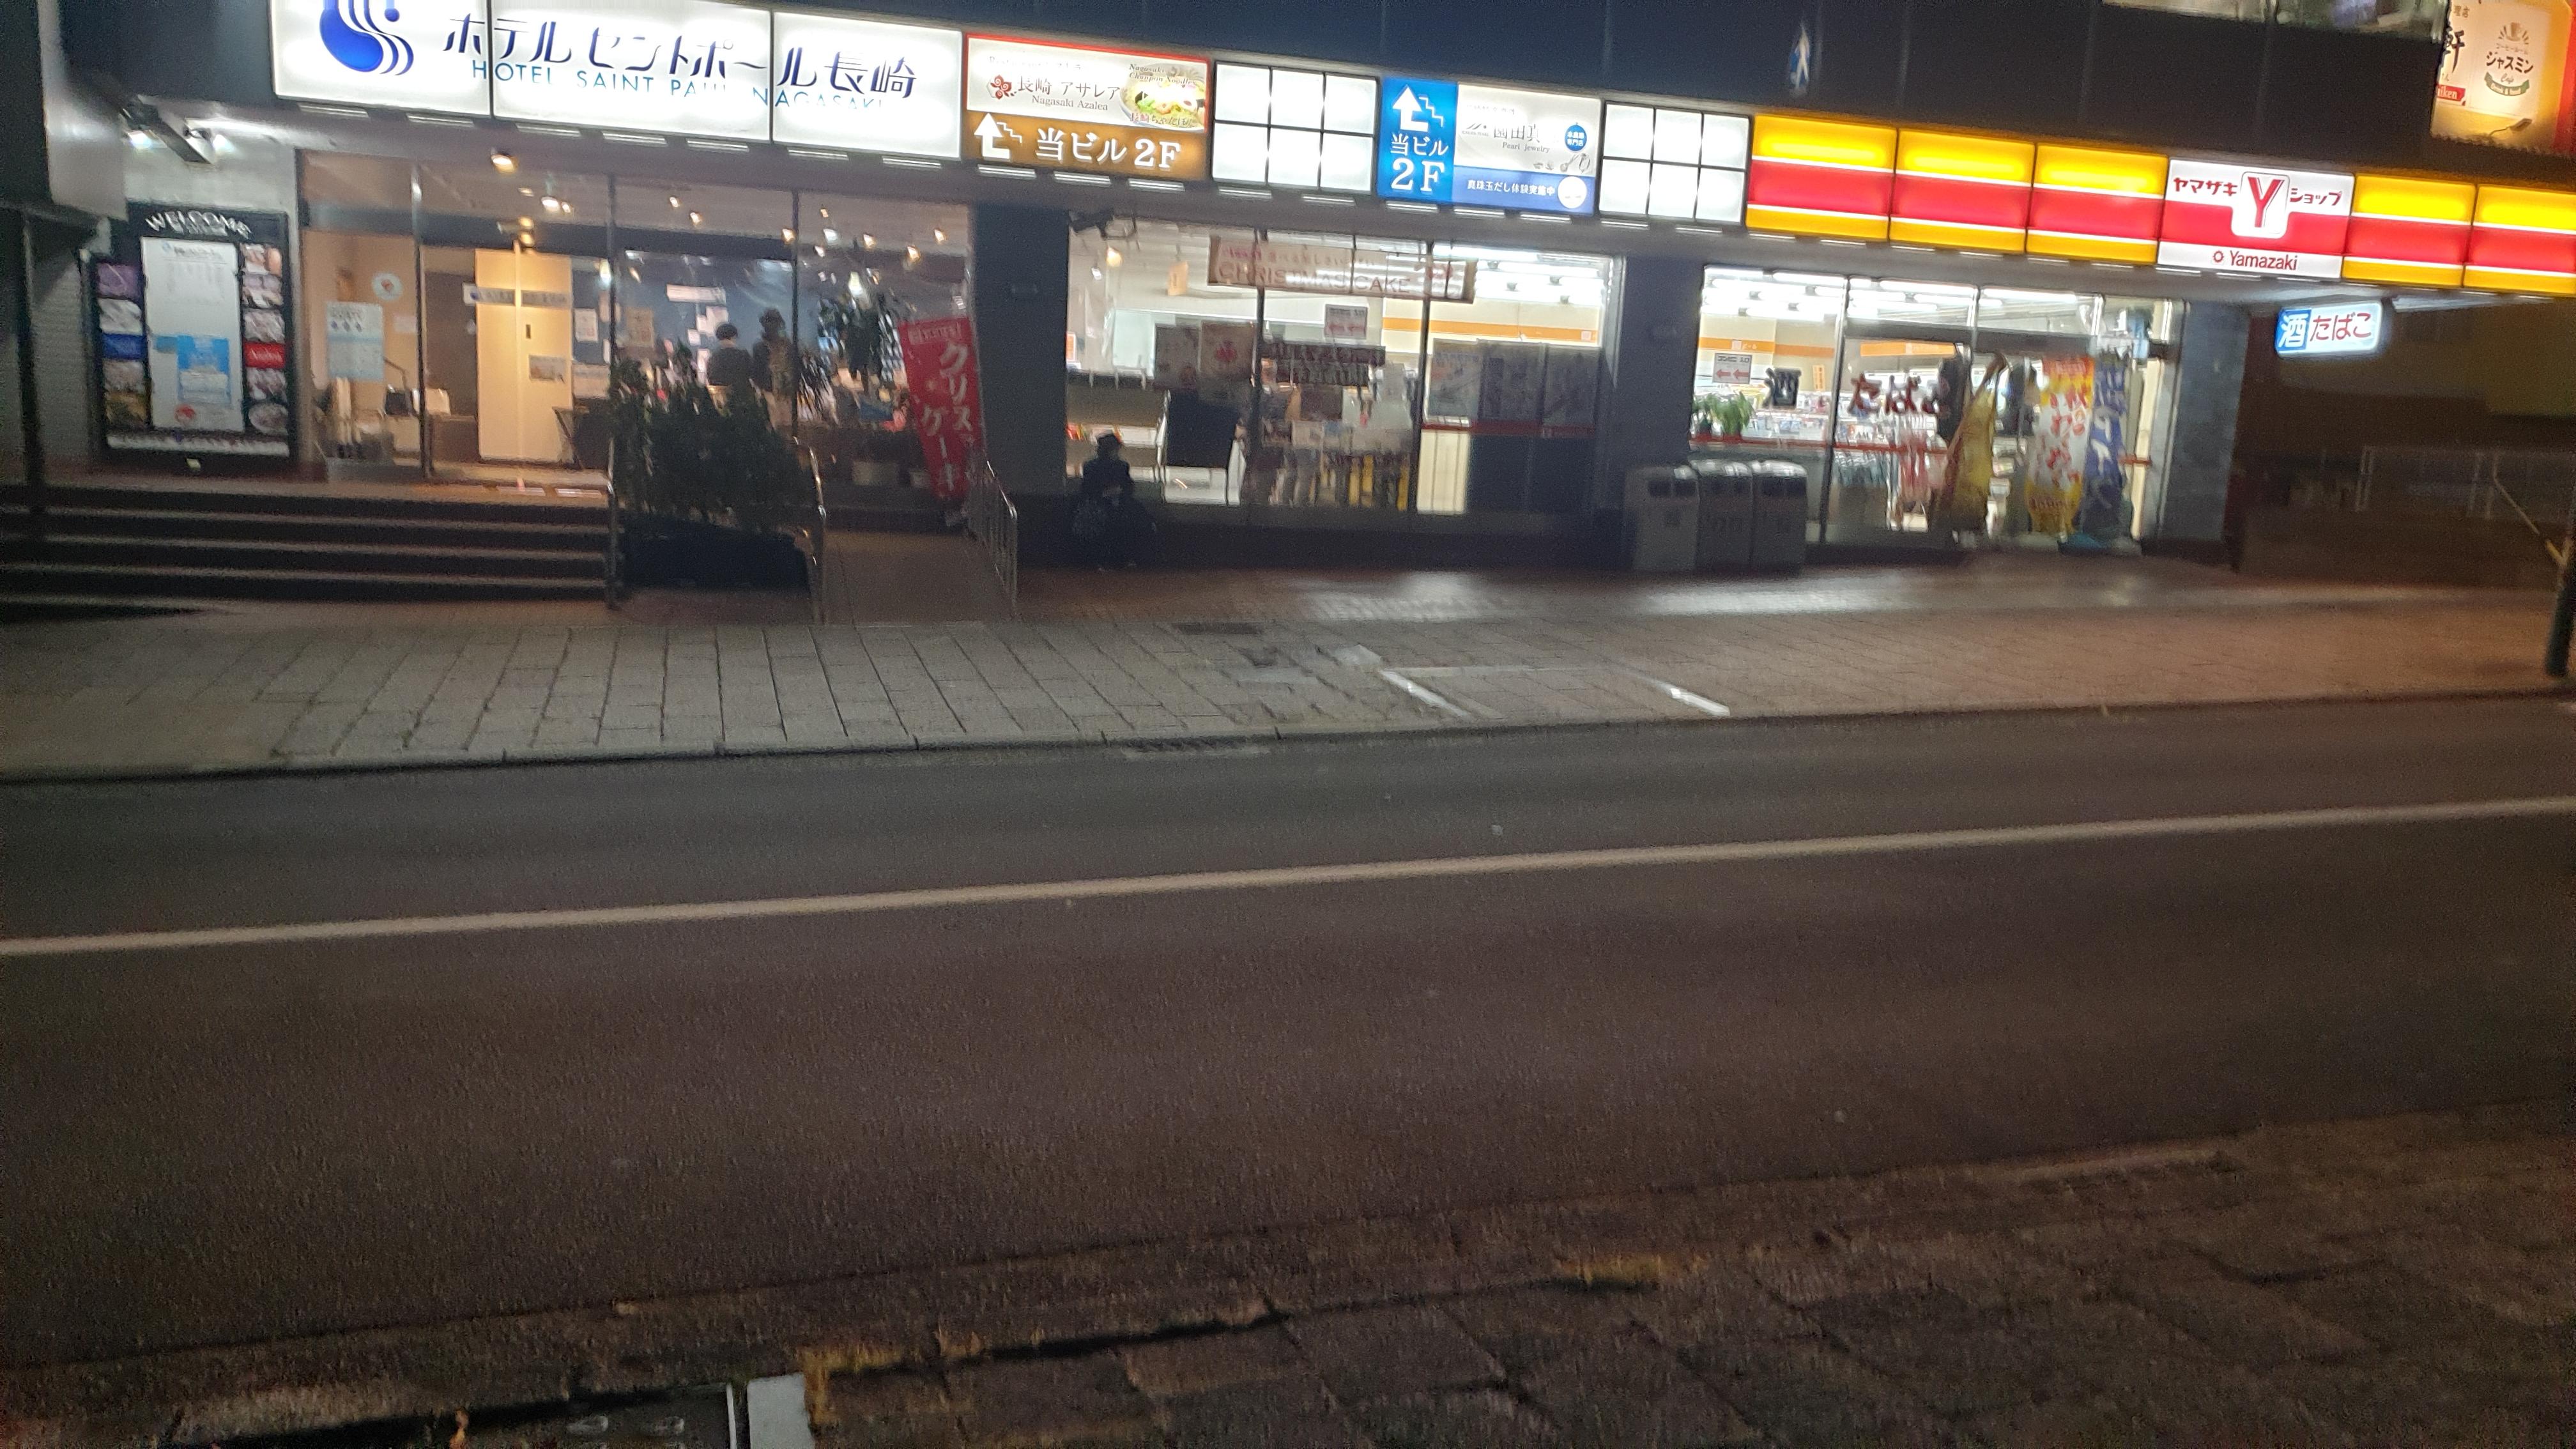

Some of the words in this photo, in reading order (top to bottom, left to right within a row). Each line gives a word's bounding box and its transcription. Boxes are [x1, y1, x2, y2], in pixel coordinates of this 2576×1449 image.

[2486, 50, 2534, 73] ジャスミン
[472, 59, 553, 86] HOTEL
[576, 70, 654, 93] SAINT
[1017, 75, 1052, 96] 長崎
[1032, 95, 1075, 108] Nagasaki
[1077, 100, 1108, 112] Azalea
[2437, 85, 2458, 100] iken
[1390, 133, 1449, 157] 当ビル
[1502, 141, 1521, 150] Pearl
[1391, 158, 1445, 192] 2F
[2173, 176, 2238, 197] ヤマザキ
[2289, 187, 2343, 206] ショップ
[2247, 176, 2285, 228] Y
[2229, 250, 2298, 272] Yamazaki
[2277, 312, 2309, 348] 酒
[2309, 311, 2373, 342] たばこ
